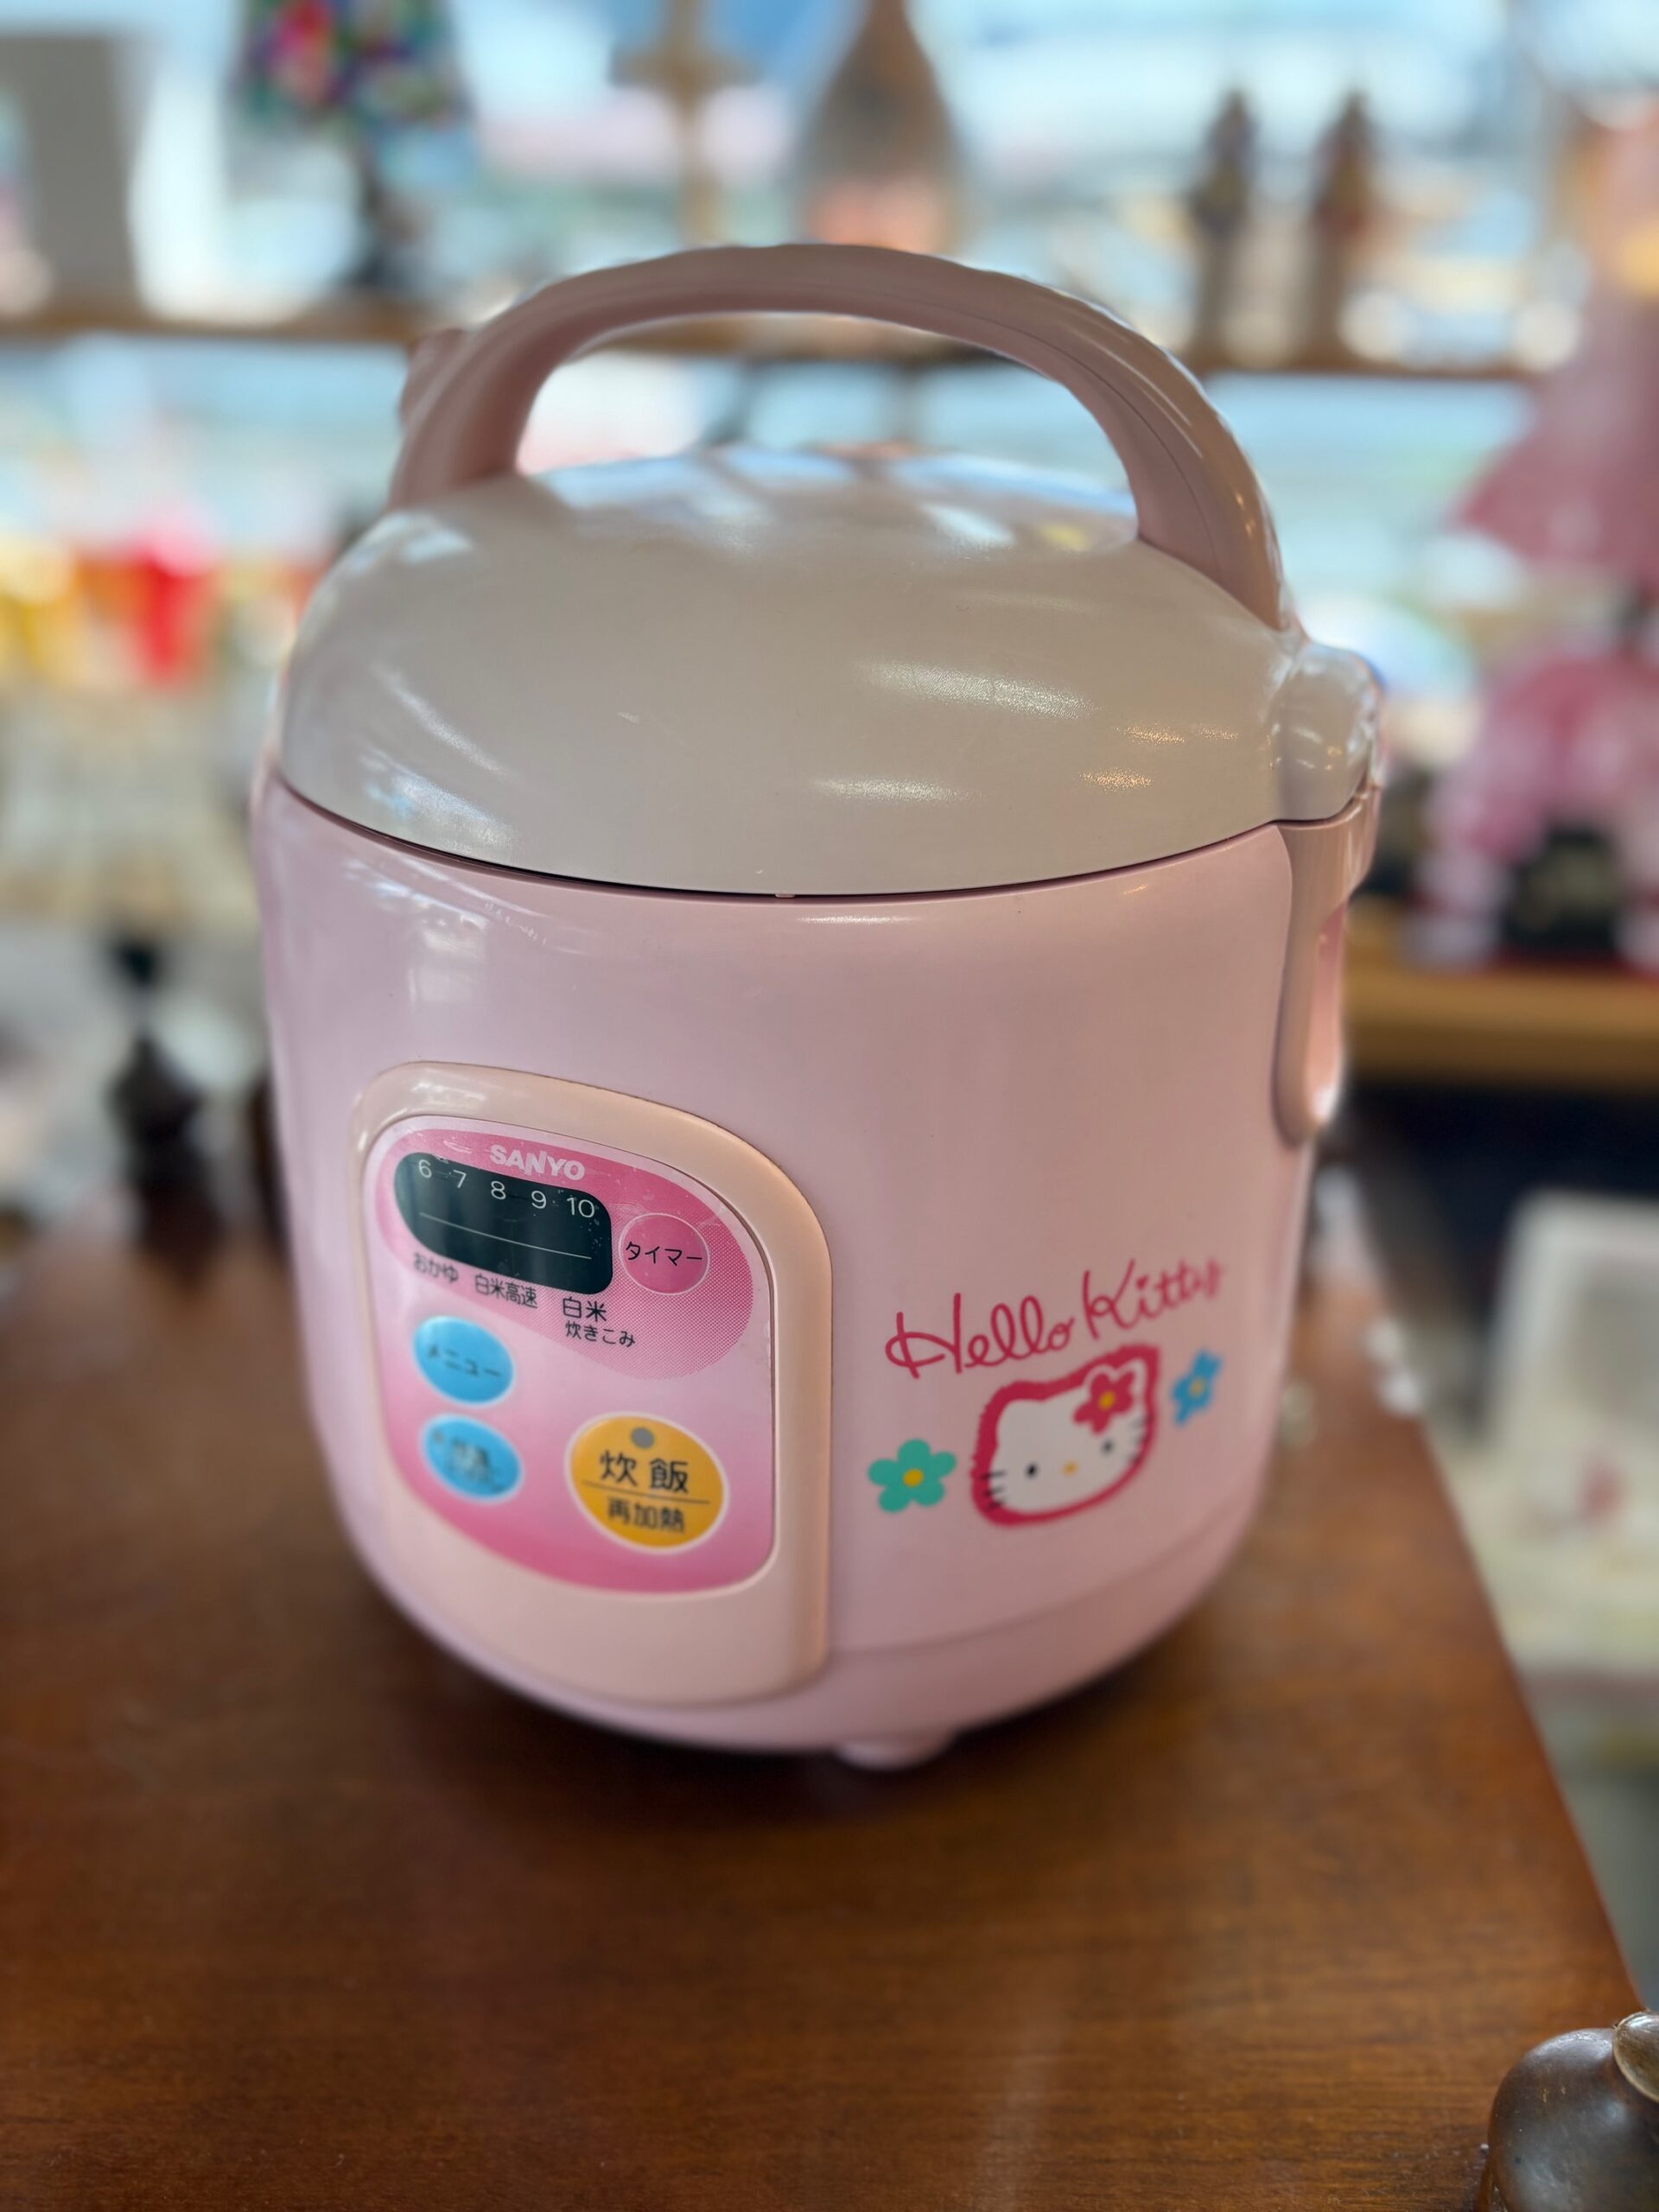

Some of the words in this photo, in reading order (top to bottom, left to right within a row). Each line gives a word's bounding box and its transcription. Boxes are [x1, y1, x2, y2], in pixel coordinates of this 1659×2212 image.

[490, 1144, 585, 1180] SANYO
[418, 1159, 433, 1179] 6
[452, 1171, 467, 1189] 7
[490, 1180, 507, 1201] 8
[531, 1190, 548, 1210] 9
[566, 1197, 596, 1218] 10
[625, 1241, 702, 1267] タイマー
[413, 1253, 459, 1283] おかゆ
[474, 1274, 538, 1308] 白米高速
[562, 1296, 607, 1322] 白米
[565, 1320, 636, 1348] 炊きこみ
[885, 1292, 1075, 1379] Hello
[1082, 1257, 1224, 1340] Kitty
[599, 1448, 689, 1495] 炊飯
[607, 1497, 686, 1535] 再加熱
